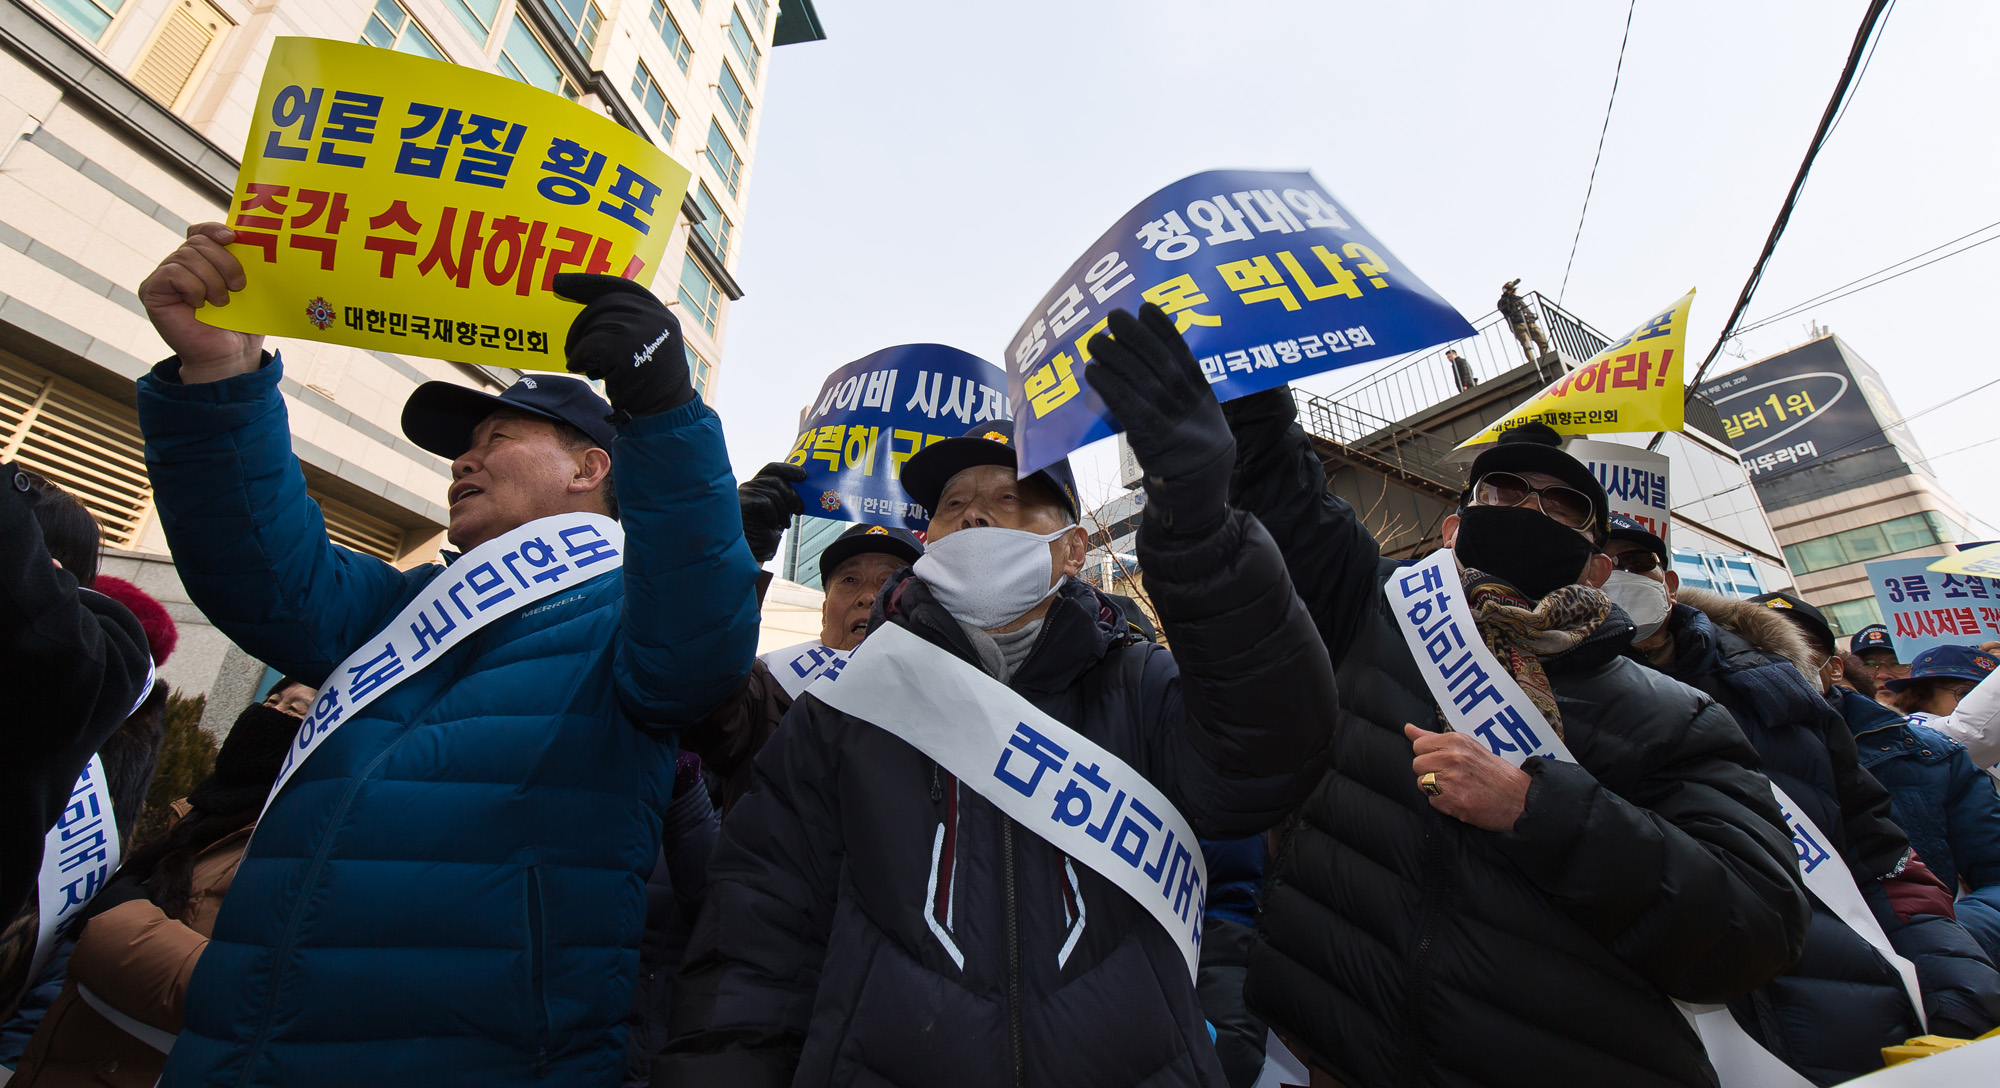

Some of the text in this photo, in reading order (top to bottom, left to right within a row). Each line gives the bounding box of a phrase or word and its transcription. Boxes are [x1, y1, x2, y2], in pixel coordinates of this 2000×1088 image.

[263, 84, 663, 236] 언론 갑질 횡포
[234, 183, 350, 271] 즉각
[1015, 188, 1351, 373] 향군은 청와대와
[1141, 273, 1222, 335] 못
[1215, 242, 1390, 312] 먹냐?
[344, 305, 550, 355] 대한민국재향군인회
[812, 369, 898, 419] 사이비
[1538, 349, 1674, 400] 사하라!
[1764, 391, 1816, 421] 1위
[787, 424, 879, 476] 강력히
[521, 594, 586, 618] MERRELL
[1885, 575, 1931, 602] 3류
[1894, 607, 1981, 638] 시사저널
[1400, 564, 1556, 761] 대한민국재
